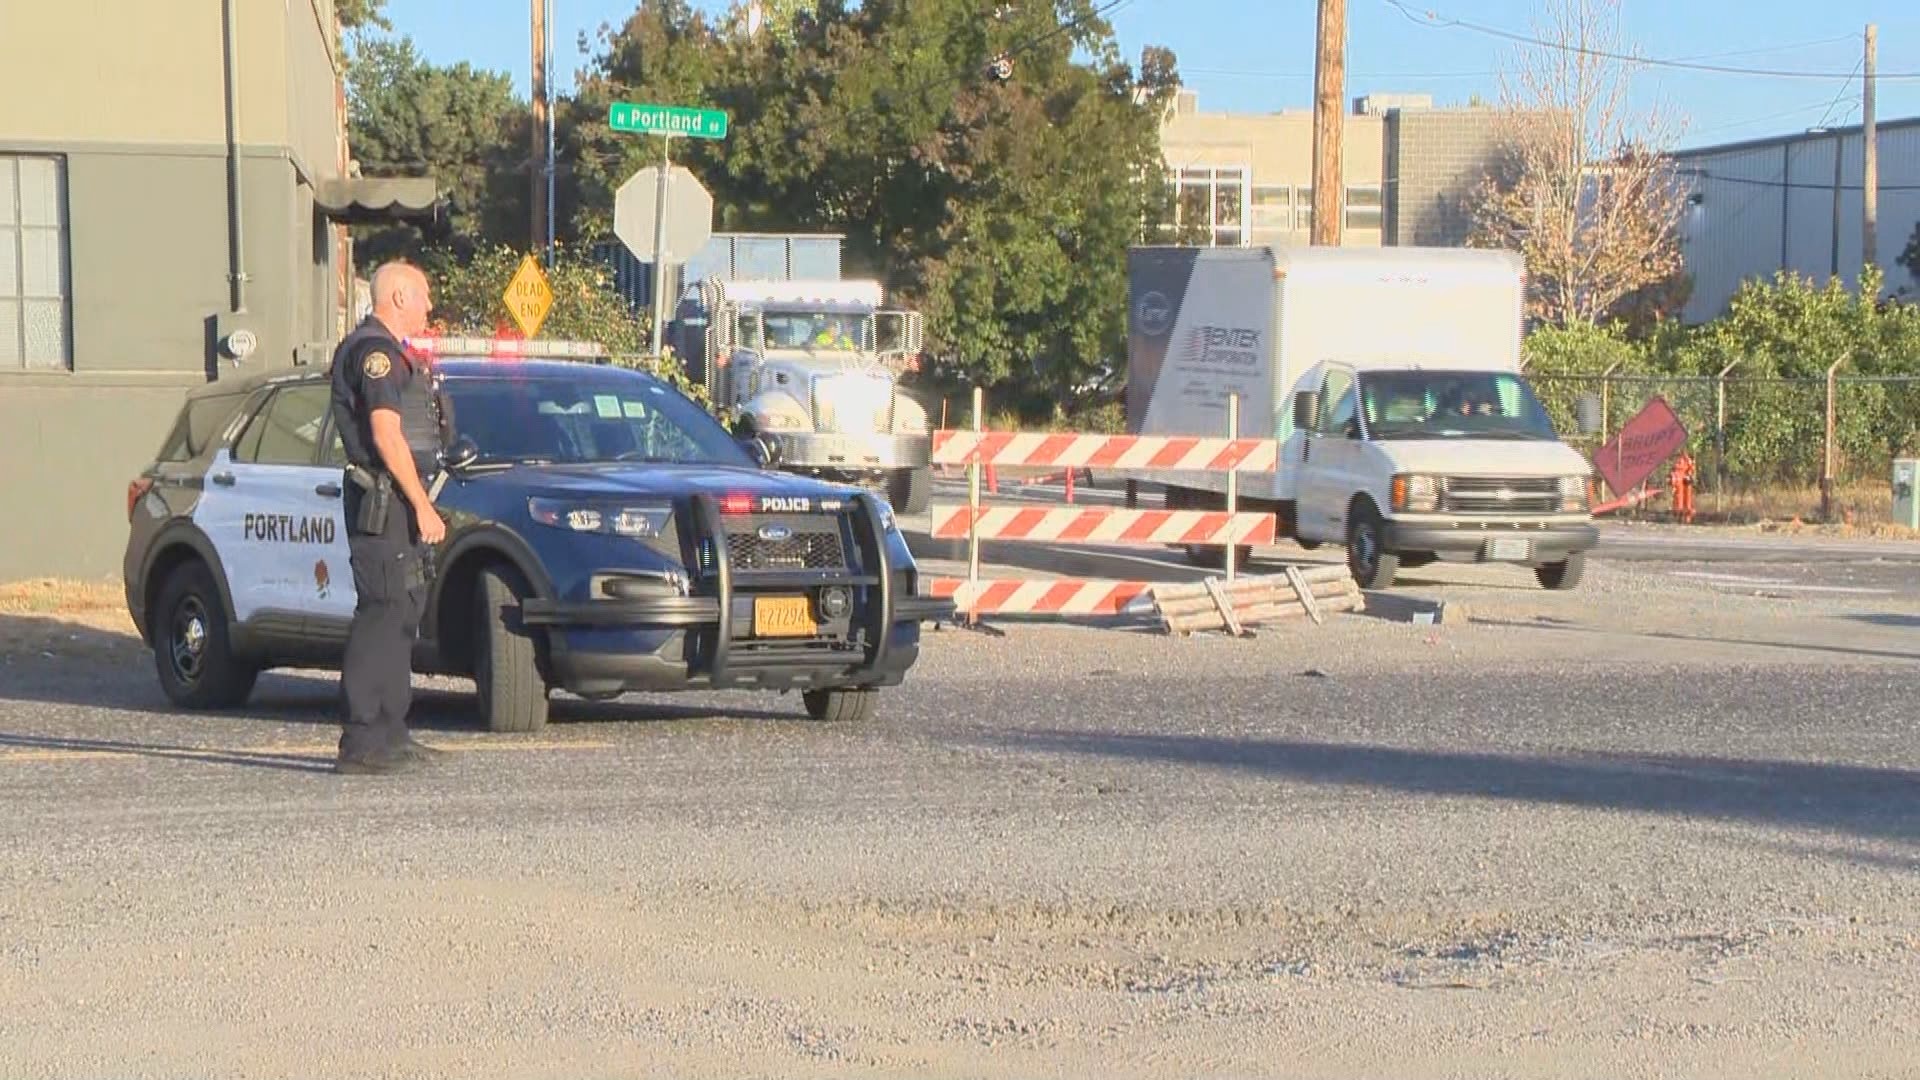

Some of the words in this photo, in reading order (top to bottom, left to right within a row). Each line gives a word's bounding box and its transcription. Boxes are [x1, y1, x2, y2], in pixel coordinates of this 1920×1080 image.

[631, 108, 703, 131] Portland
[516, 282, 544, 297] DEAD
[521, 303, 541, 318] END
[762, 497, 810, 511] POLICE
[245, 513, 335, 544] PORTLAND
